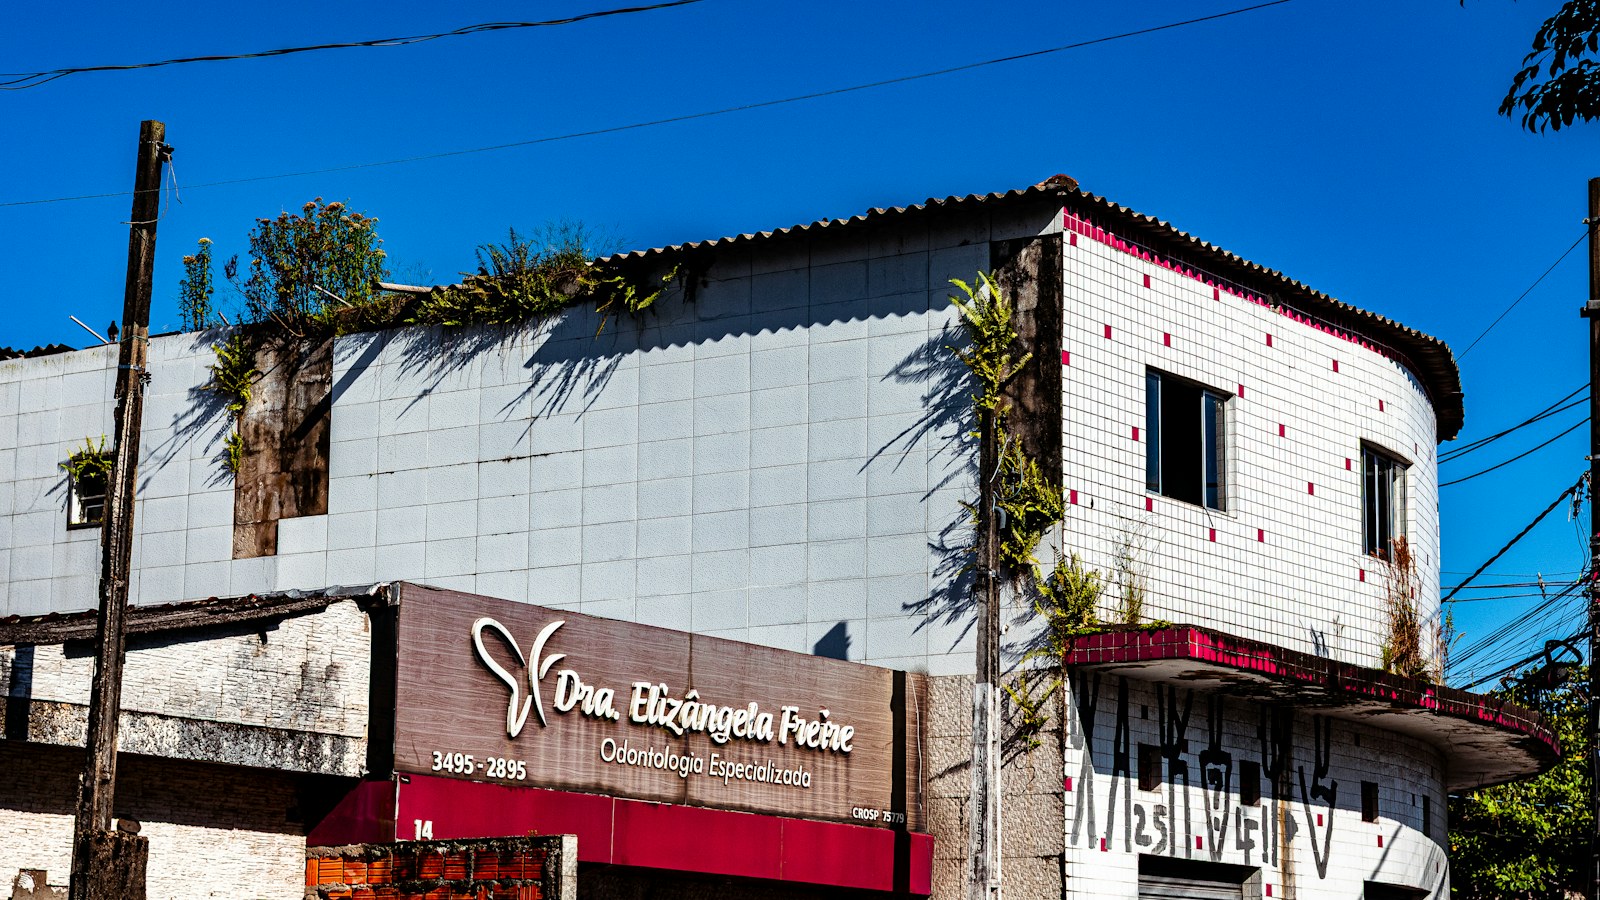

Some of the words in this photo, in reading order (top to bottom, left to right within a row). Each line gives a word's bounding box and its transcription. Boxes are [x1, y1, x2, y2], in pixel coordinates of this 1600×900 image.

[553, 669, 620, 721] Dra.
[628, 681, 774, 744] Elizângela
[778, 705, 855, 753] Freire
[600, 737, 704, 778] Odontologia
[708, 753, 812, 788] Especializada
[413, 819, 434, 841] 14
[852, 807, 879, 821] CROSP
[882, 810, 905, 824] 75779
